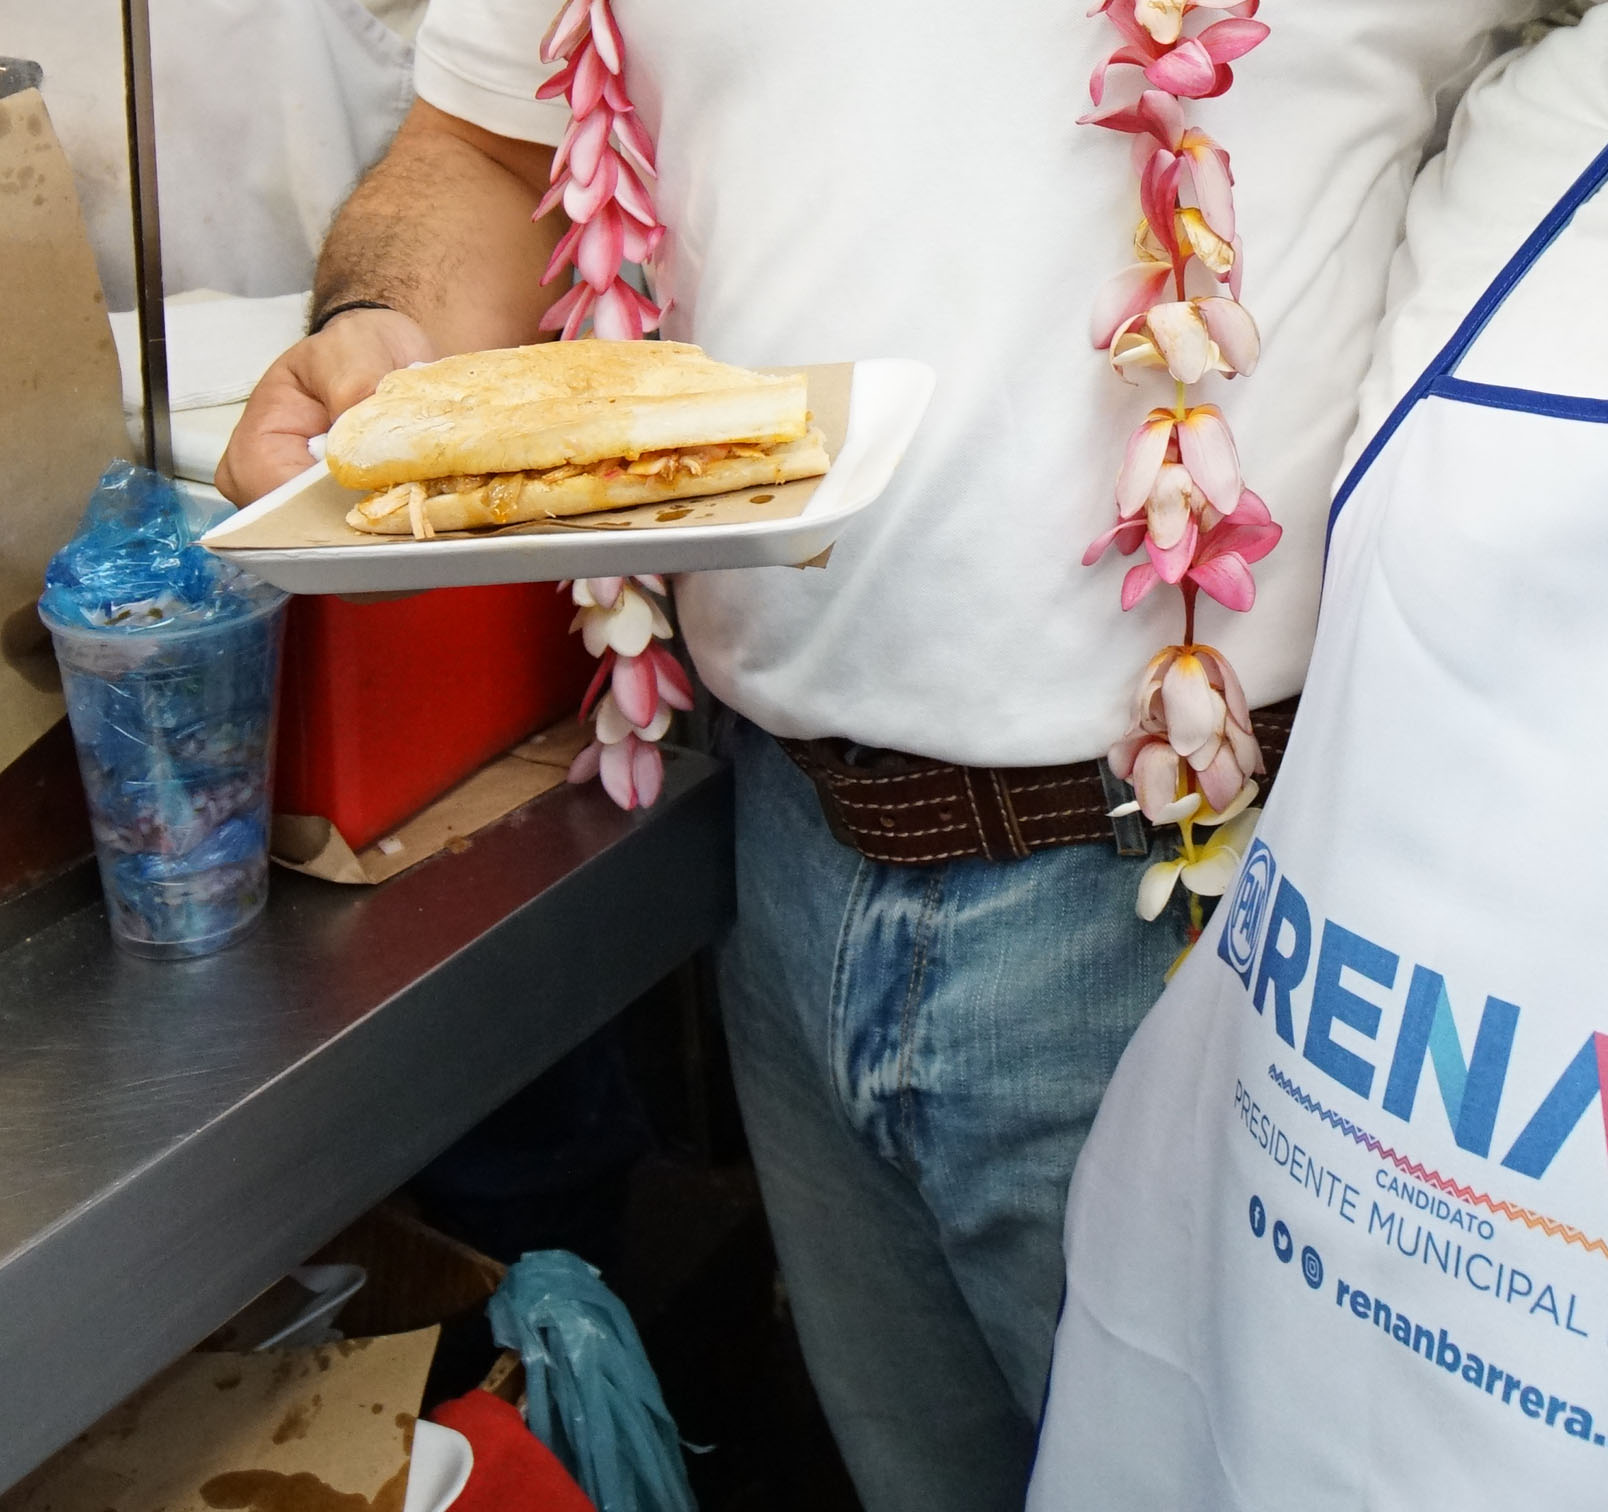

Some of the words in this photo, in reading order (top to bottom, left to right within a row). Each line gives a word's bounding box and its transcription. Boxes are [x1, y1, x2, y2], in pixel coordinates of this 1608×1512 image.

[1234, 1078, 1361, 1224] PRESIDENTE
[1367, 1200, 1589, 1338] MUNICIPAL
[1375, 1168, 1495, 1241] CANDIDATO
